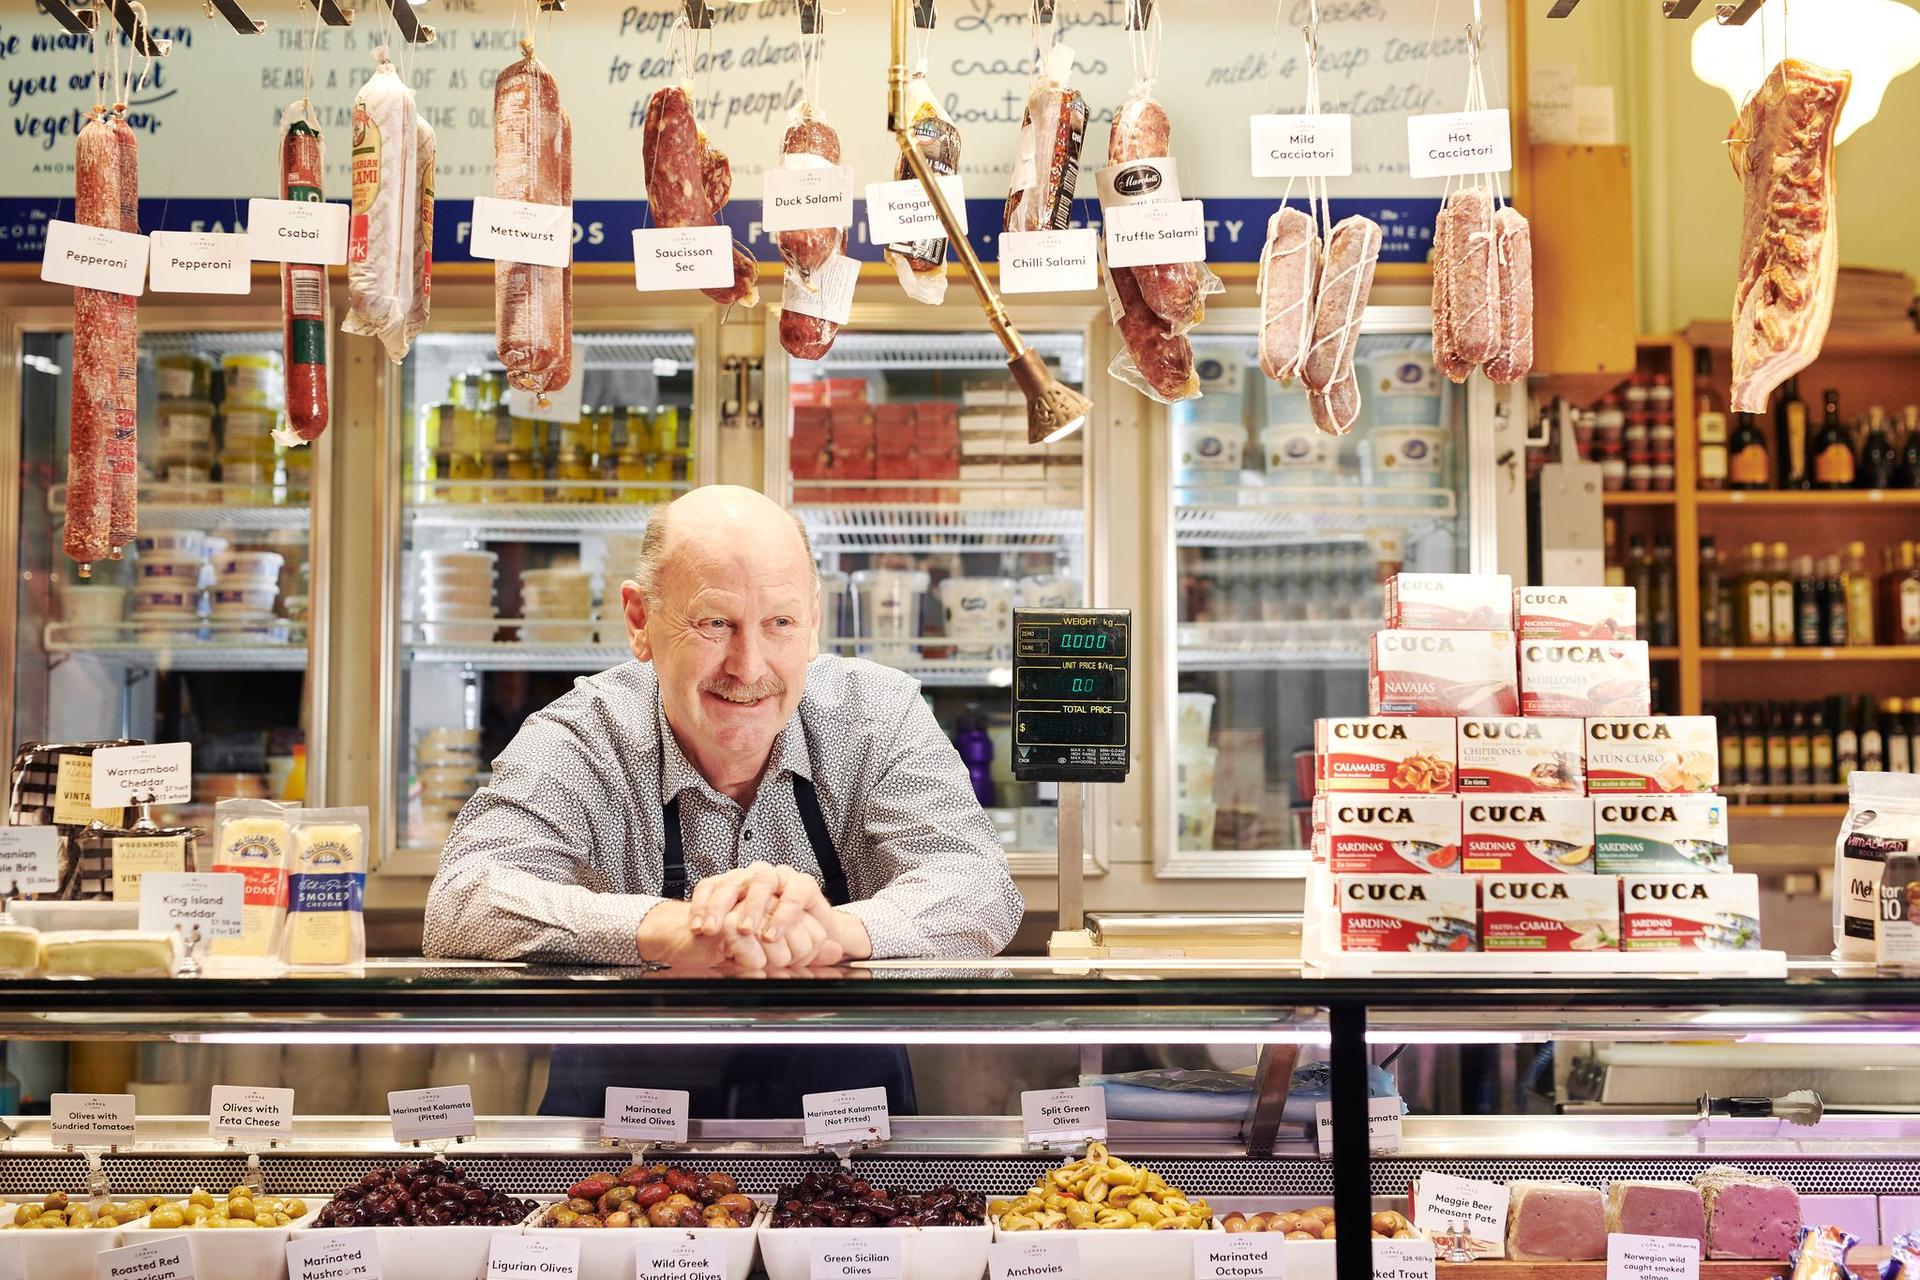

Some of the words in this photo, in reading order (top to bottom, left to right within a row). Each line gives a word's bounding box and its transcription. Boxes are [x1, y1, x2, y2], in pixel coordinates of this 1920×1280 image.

[9, 73, 57, 107] you
[1290, 136, 1314, 144] Mild
[1449, 133, 1472, 142] Hot
[1270, 148, 1334, 160] Cacciatori
[1429, 146, 1493, 160] Cacciatori
[776, 196, 802, 207] Duck
[806, 192, 842, 204] Salami
[278, 228, 320, 239] Csabai
[490, 225, 554, 242] Mettwurst
[1115, 230, 1155, 242] Truffle
[1158, 228, 1198, 240] Salami
[656, 247, 713, 258] Saucisson
[66, 250, 128, 269] Pepperoni
[172, 258, 232, 270] Pepperoni
[1012, 257, 1042, 268] Chilli
[1046, 256, 1086, 266] Salami
[676, 262, 695, 272] Sec
[1402, 581, 1445, 591] CUCA
[1525, 595, 1568, 604] CUCA
[1103, 618, 1114, 628] kg
[1062, 634, 1106, 648] 0.000
[1384, 637, 1456, 652] CUCA
[1526, 647, 1605, 662] CUCA
[1098, 662, 1113, 671] $/kg
[1072, 679, 1094, 692] 0.0
[1385, 682, 1435, 693] NAVAJAS
[1020, 723, 1026, 732] $
[1334, 724, 1407, 739] CUCA
[1464, 723, 1542, 739] CUCA
[1591, 724, 1671, 740] CUCA
[1626, 754, 1664, 764] CLARO
[106, 764, 178, 776] Warrnambool
[1334, 764, 1386, 772] CALAMARES
[120, 778, 164, 788] Cheddar
[1338, 808, 1414, 823] CUCA
[1470, 806, 1546, 822] CUCA
[1602, 806, 1677, 822] CUCA
[244, 834, 269, 844] ISLAND
[314, 841, 340, 850] ISLAND
[1337, 842, 1383, 851] SARDINAS
[1469, 842, 1516, 850] SARDINAS
[1599, 843, 1644, 851] SARDINAS
[16, 864, 37, 872] Brie
[244, 886, 276, 896] DDAR
[1349, 884, 1426, 900] CUCA
[1490, 882, 1568, 899] CUCA
[1631, 884, 1708, 899] CUCA
[163, 895, 188, 906] King
[191, 895, 223, 905] Island
[299, 892, 350, 902] SMOKED
[169, 909, 216, 918] Cheddar
[1882, 899, 1901, 920] 10
[1348, 919, 1401, 928] SARDINAS
[1520, 921, 1563, 930] CABALLA
[1631, 919, 1672, 927] SARDINAS
[222, 1103, 253, 1113] Olives
[255, 1104, 279, 1114] with
[393, 1104, 431, 1115] Marinated
[433, 1102, 471, 1112] Kalamata
[625, 1105, 671, 1115] Marinated
[807, 1108, 846, 1118] Marinated
[848, 1104, 886, 1114] Kalamata
[1041, 1106, 1061, 1116] Split
[1063, 1105, 1090, 1113] Green
[100, 1112, 117, 1120] with
[418, 1112, 448, 1122] (Pitted)
[620, 1116, 646, 1124] Mixed
[649, 1116, 676, 1126] Olives
[824, 1117, 842, 1126] (Not
[844, 1115, 871, 1124] Pitted)
[1053, 1116, 1080, 1125] Olives
[52, 1122, 90, 1131] Sundried
[92, 1123, 135, 1131] Tomatoes
[219, 1117, 242, 1126] Feta
[245, 1117, 280, 1127] Cheese
[1435, 1194, 1470, 1208] Maggie
[1472, 1201, 1493, 1212] Beer
[1428, 1205, 1472, 1220] Pheasant
[1475, 1213, 1496, 1224] Pate
[304, 1250, 361, 1267] Marinated
[824, 1254, 853, 1263] Green
[855, 1254, 889, 1262] Sicilian
[1210, 1251, 1268, 1262] Marinated
[1624, 1253, 1666, 1263] Norwegian
[111, 1260, 156, 1276] Roasted
[159, 1256, 180, 1267] Red
[492, 1260, 536, 1273] Ligurian
[540, 1263, 573, 1274] Olives
[652, 1259, 676, 1268] Wild
[678, 1258, 709, 1268] Greek
[640, 1272, 686, 1280] Sundried
[689, 1272, 721, 1280] Olives
[842, 1266, 871, 1275] Olives
[1006, 1264, 1063, 1277] Anchovies
[1216, 1266, 1263, 1278] Octopus
[1398, 1270, 1428, 1279] Trout
